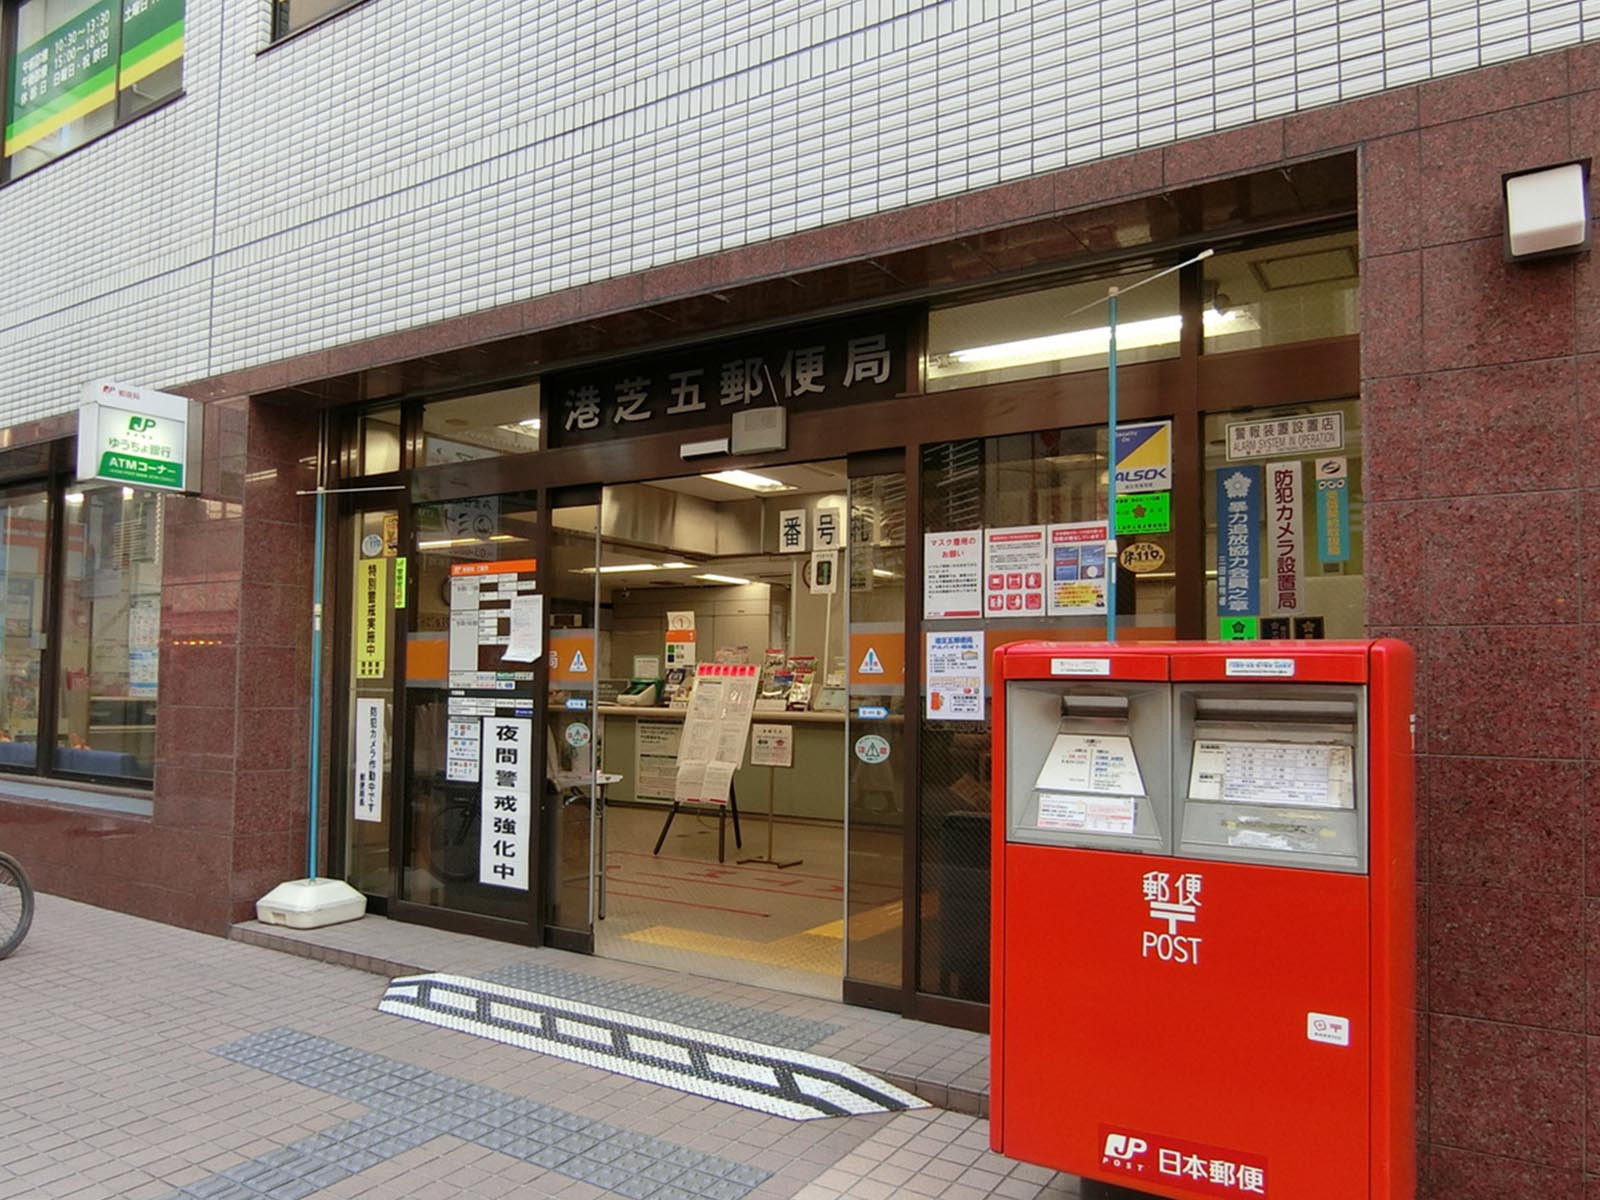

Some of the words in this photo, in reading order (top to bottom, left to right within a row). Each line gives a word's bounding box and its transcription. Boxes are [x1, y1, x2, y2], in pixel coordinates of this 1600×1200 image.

[565, 334, 891, 431] 港芝五郵便局
[128, 416, 156, 432] JP
[1235, 417, 1333, 440] 警報装置設置店
[109, 437, 171, 458] ゆうちょ銀行
[1258, 437, 1285, 449] SYSTEM
[1288, 436, 1297, 446] IN
[1298, 432, 1336, 446] OPERATION
[108, 457, 176, 475] ATMコーナー
[1115, 468, 1167, 482] ALSOK
[1274, 470, 1297, 609] 防犯カメラ設置局
[1228, 501, 1249, 611] 暴力追放協力会員之章
[493, 725, 519, 880] 夜間警戒強化中
[1143, 871, 1202, 906] 郵便
[1143, 931, 1202, 965] POST
[1104, 1133, 1148, 1160] JP
[1102, 1156, 1144, 1172] POST
[1159, 1148, 1265, 1194] 日本郵便
